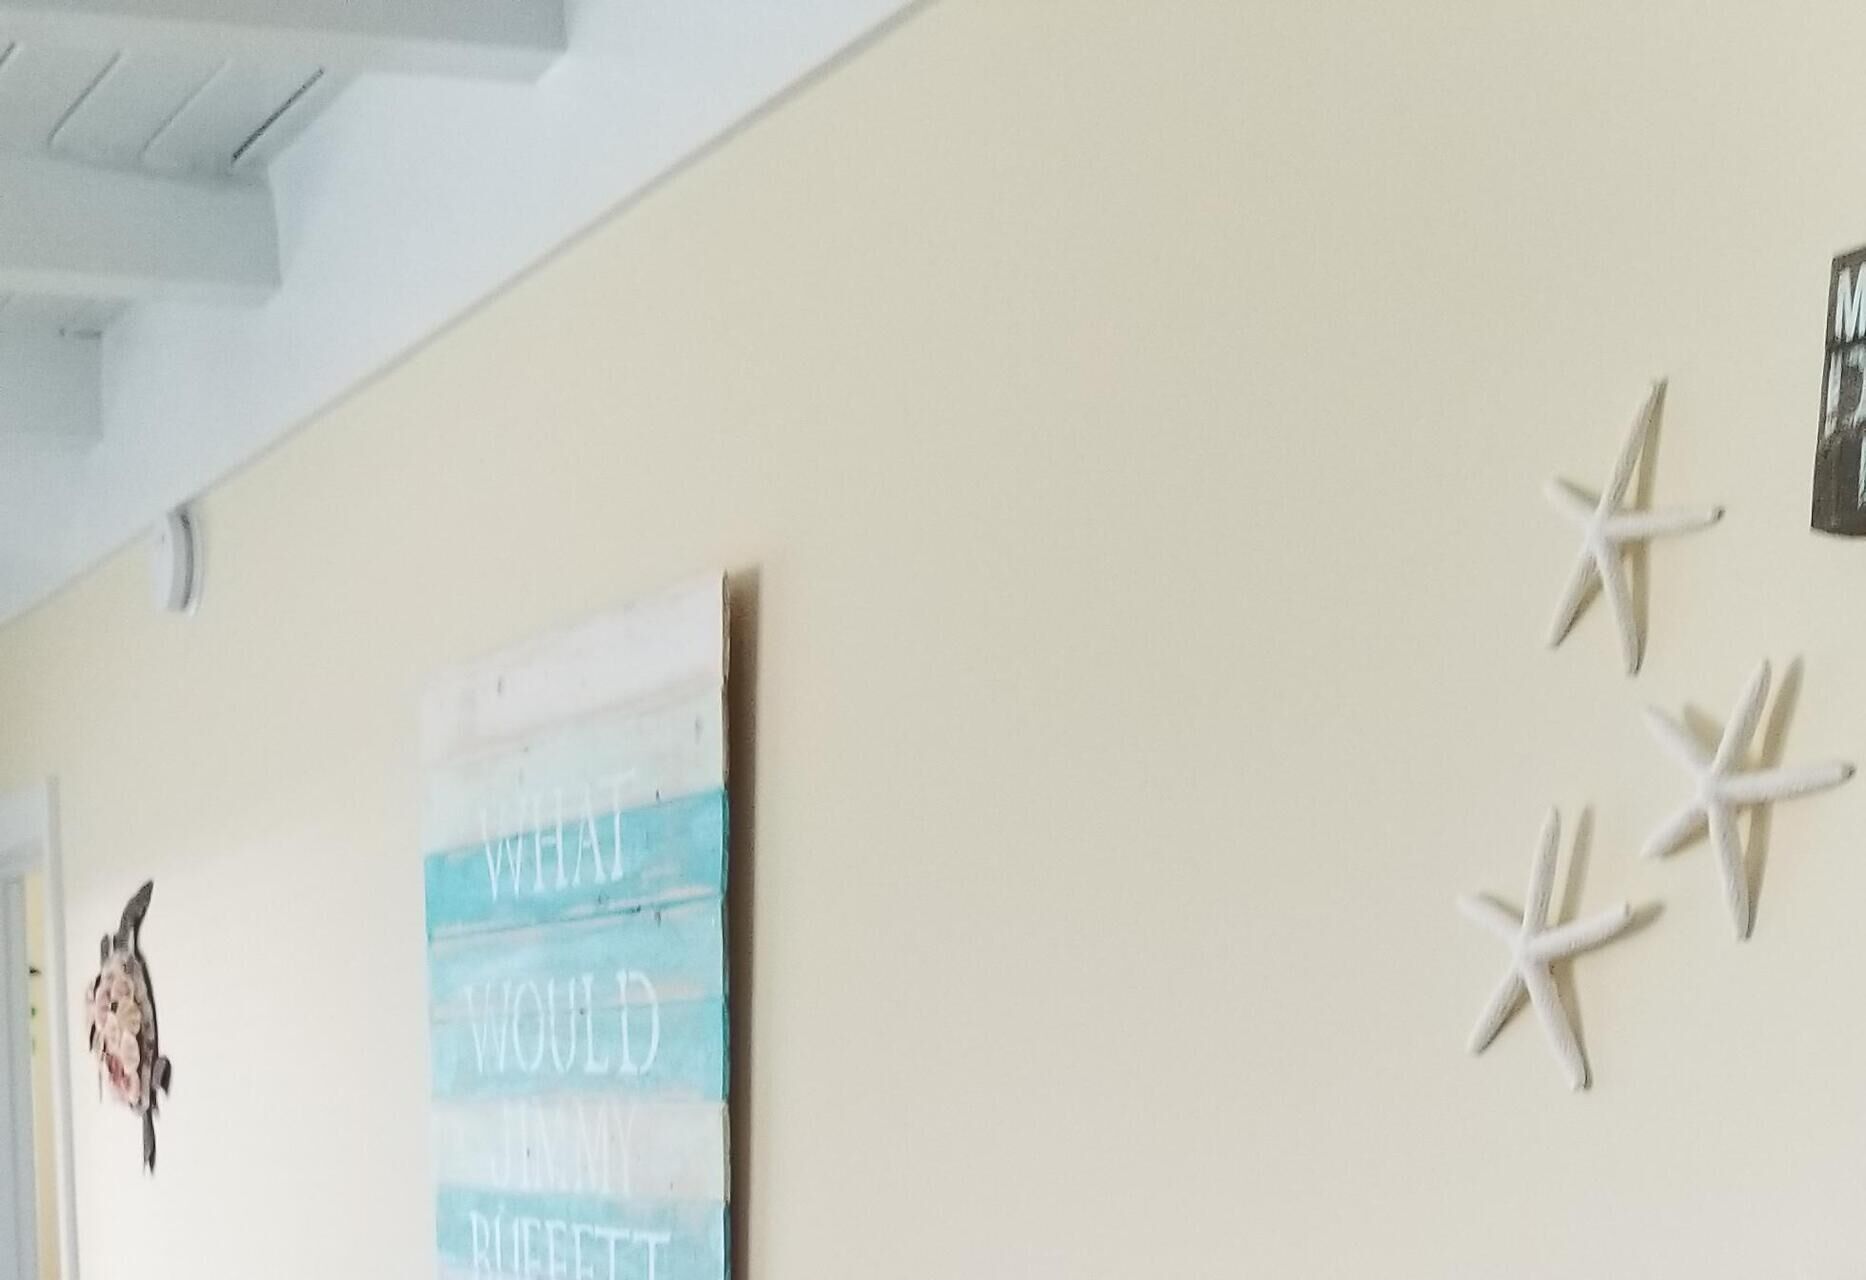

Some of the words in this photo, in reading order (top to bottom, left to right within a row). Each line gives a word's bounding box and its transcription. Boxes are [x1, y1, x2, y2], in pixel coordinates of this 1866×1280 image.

[480, 767, 636, 904] WHAT
[463, 968, 660, 1076] WOULD
[490, 1096, 640, 1199] JIMMY
